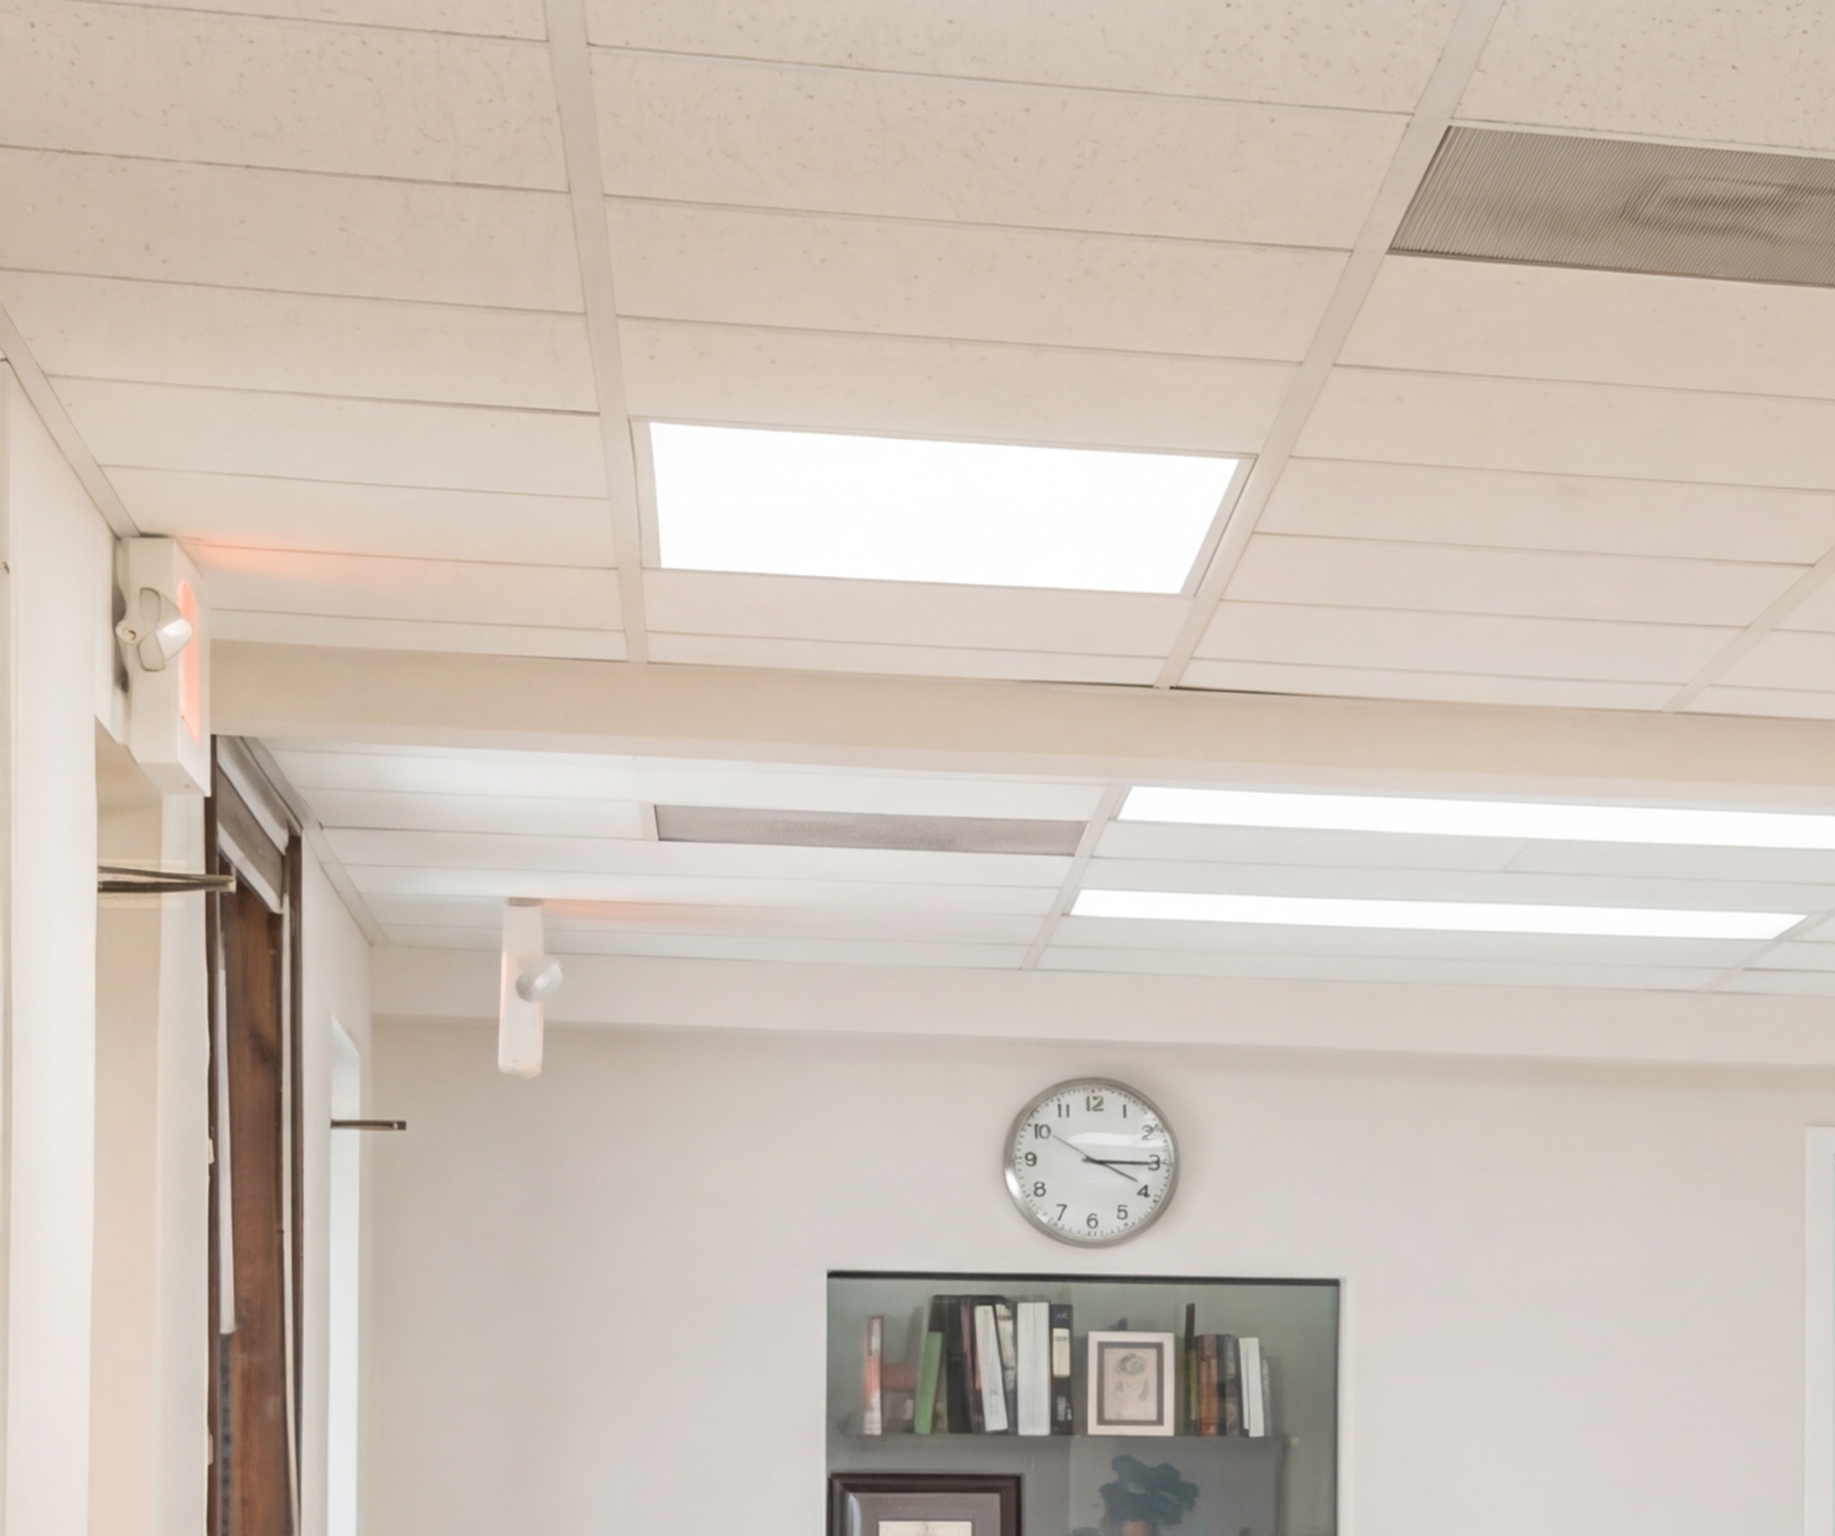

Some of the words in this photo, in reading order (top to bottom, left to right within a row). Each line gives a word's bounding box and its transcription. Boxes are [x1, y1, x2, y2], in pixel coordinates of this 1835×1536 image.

[1057, 1103, 1071, 1118] 11
[1085, 1095, 1105, 1112] 12
[1122, 1104, 1128, 1118] 1
[1033, 1123, 1052, 1140] 10
[1141, 1124, 1154, 1141] 2
[1024, 1151, 1038, 1167] 9
[1148, 1154, 1161, 1171] 3
[1033, 1181, 1047, 1197] 8
[1136, 1184, 1150, 1198] 4
[1056, 1203, 1068, 1221] 7
[1116, 1204, 1129, 1220] 5
[1086, 1212, 1099, 1229] 6
